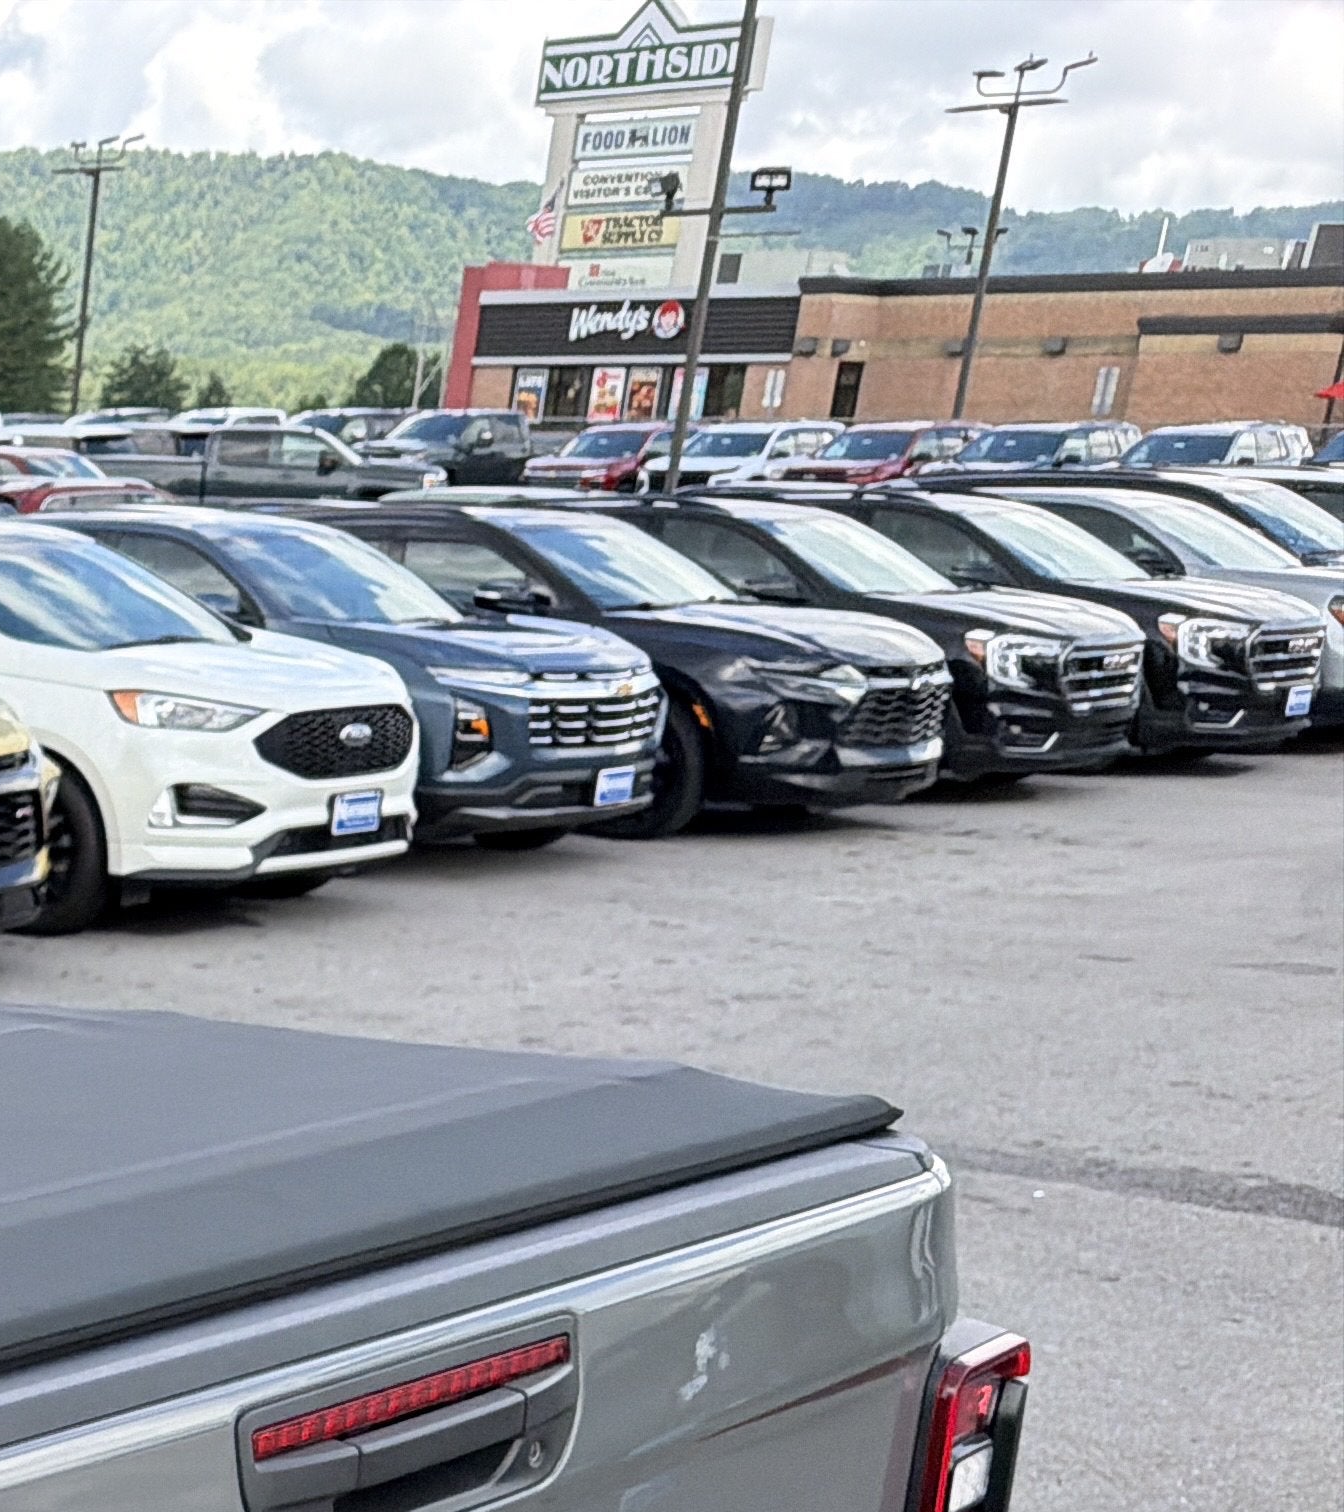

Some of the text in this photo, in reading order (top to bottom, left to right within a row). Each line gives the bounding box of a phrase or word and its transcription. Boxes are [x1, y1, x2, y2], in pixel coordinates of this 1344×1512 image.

[581, 125, 692, 151] FOOD LION
[568, 300, 651, 342] Wendy's
